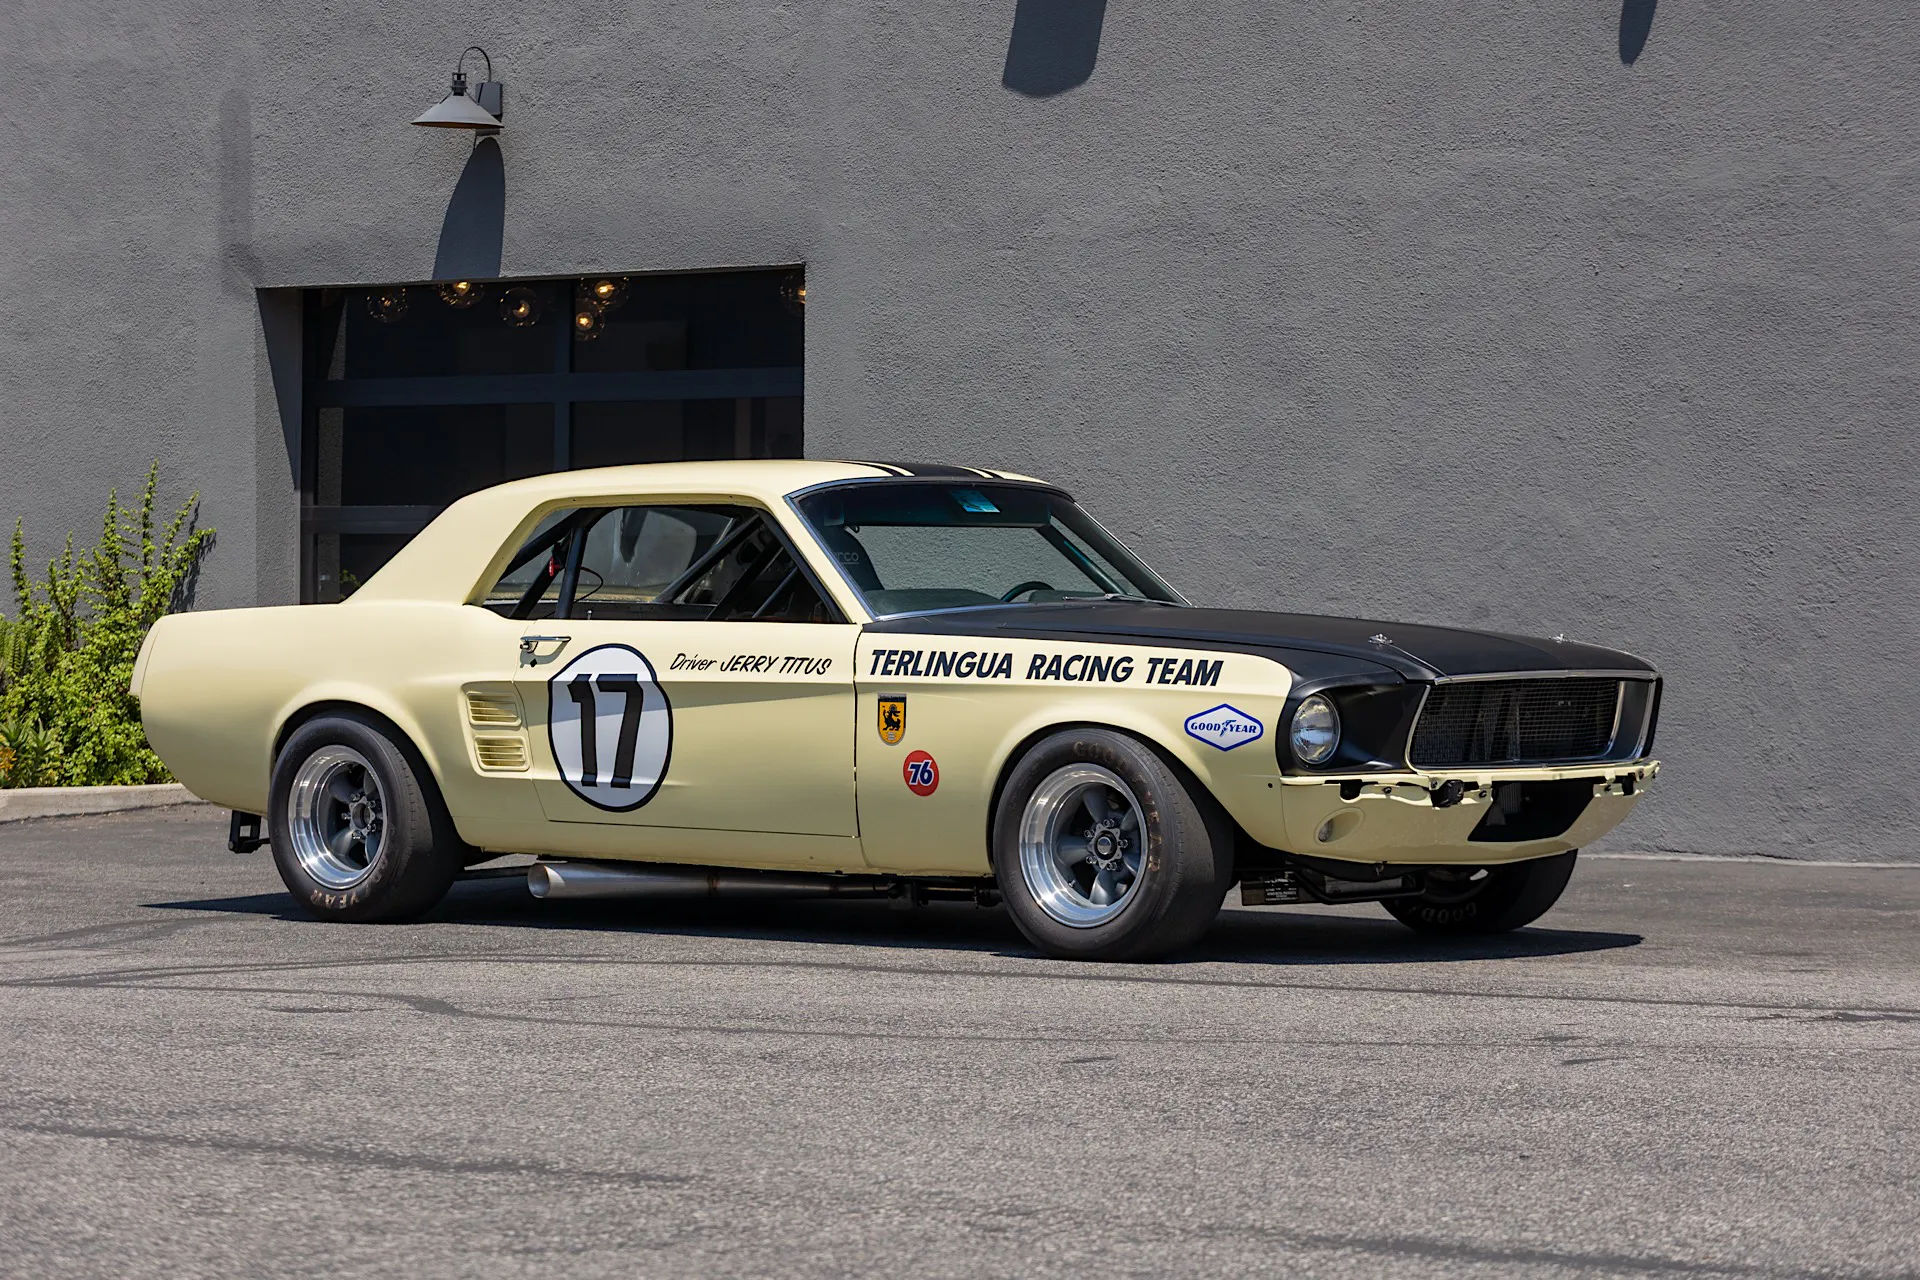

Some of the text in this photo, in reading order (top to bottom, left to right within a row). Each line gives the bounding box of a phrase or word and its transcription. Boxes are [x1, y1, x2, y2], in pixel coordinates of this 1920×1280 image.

[669, 652, 832, 675] Driver JERRY TITUS
[869, 649, 1224, 687] TERLINGUA RACING TEAM
[567, 673, 644, 789] 17
[907, 760, 934, 786] 76
